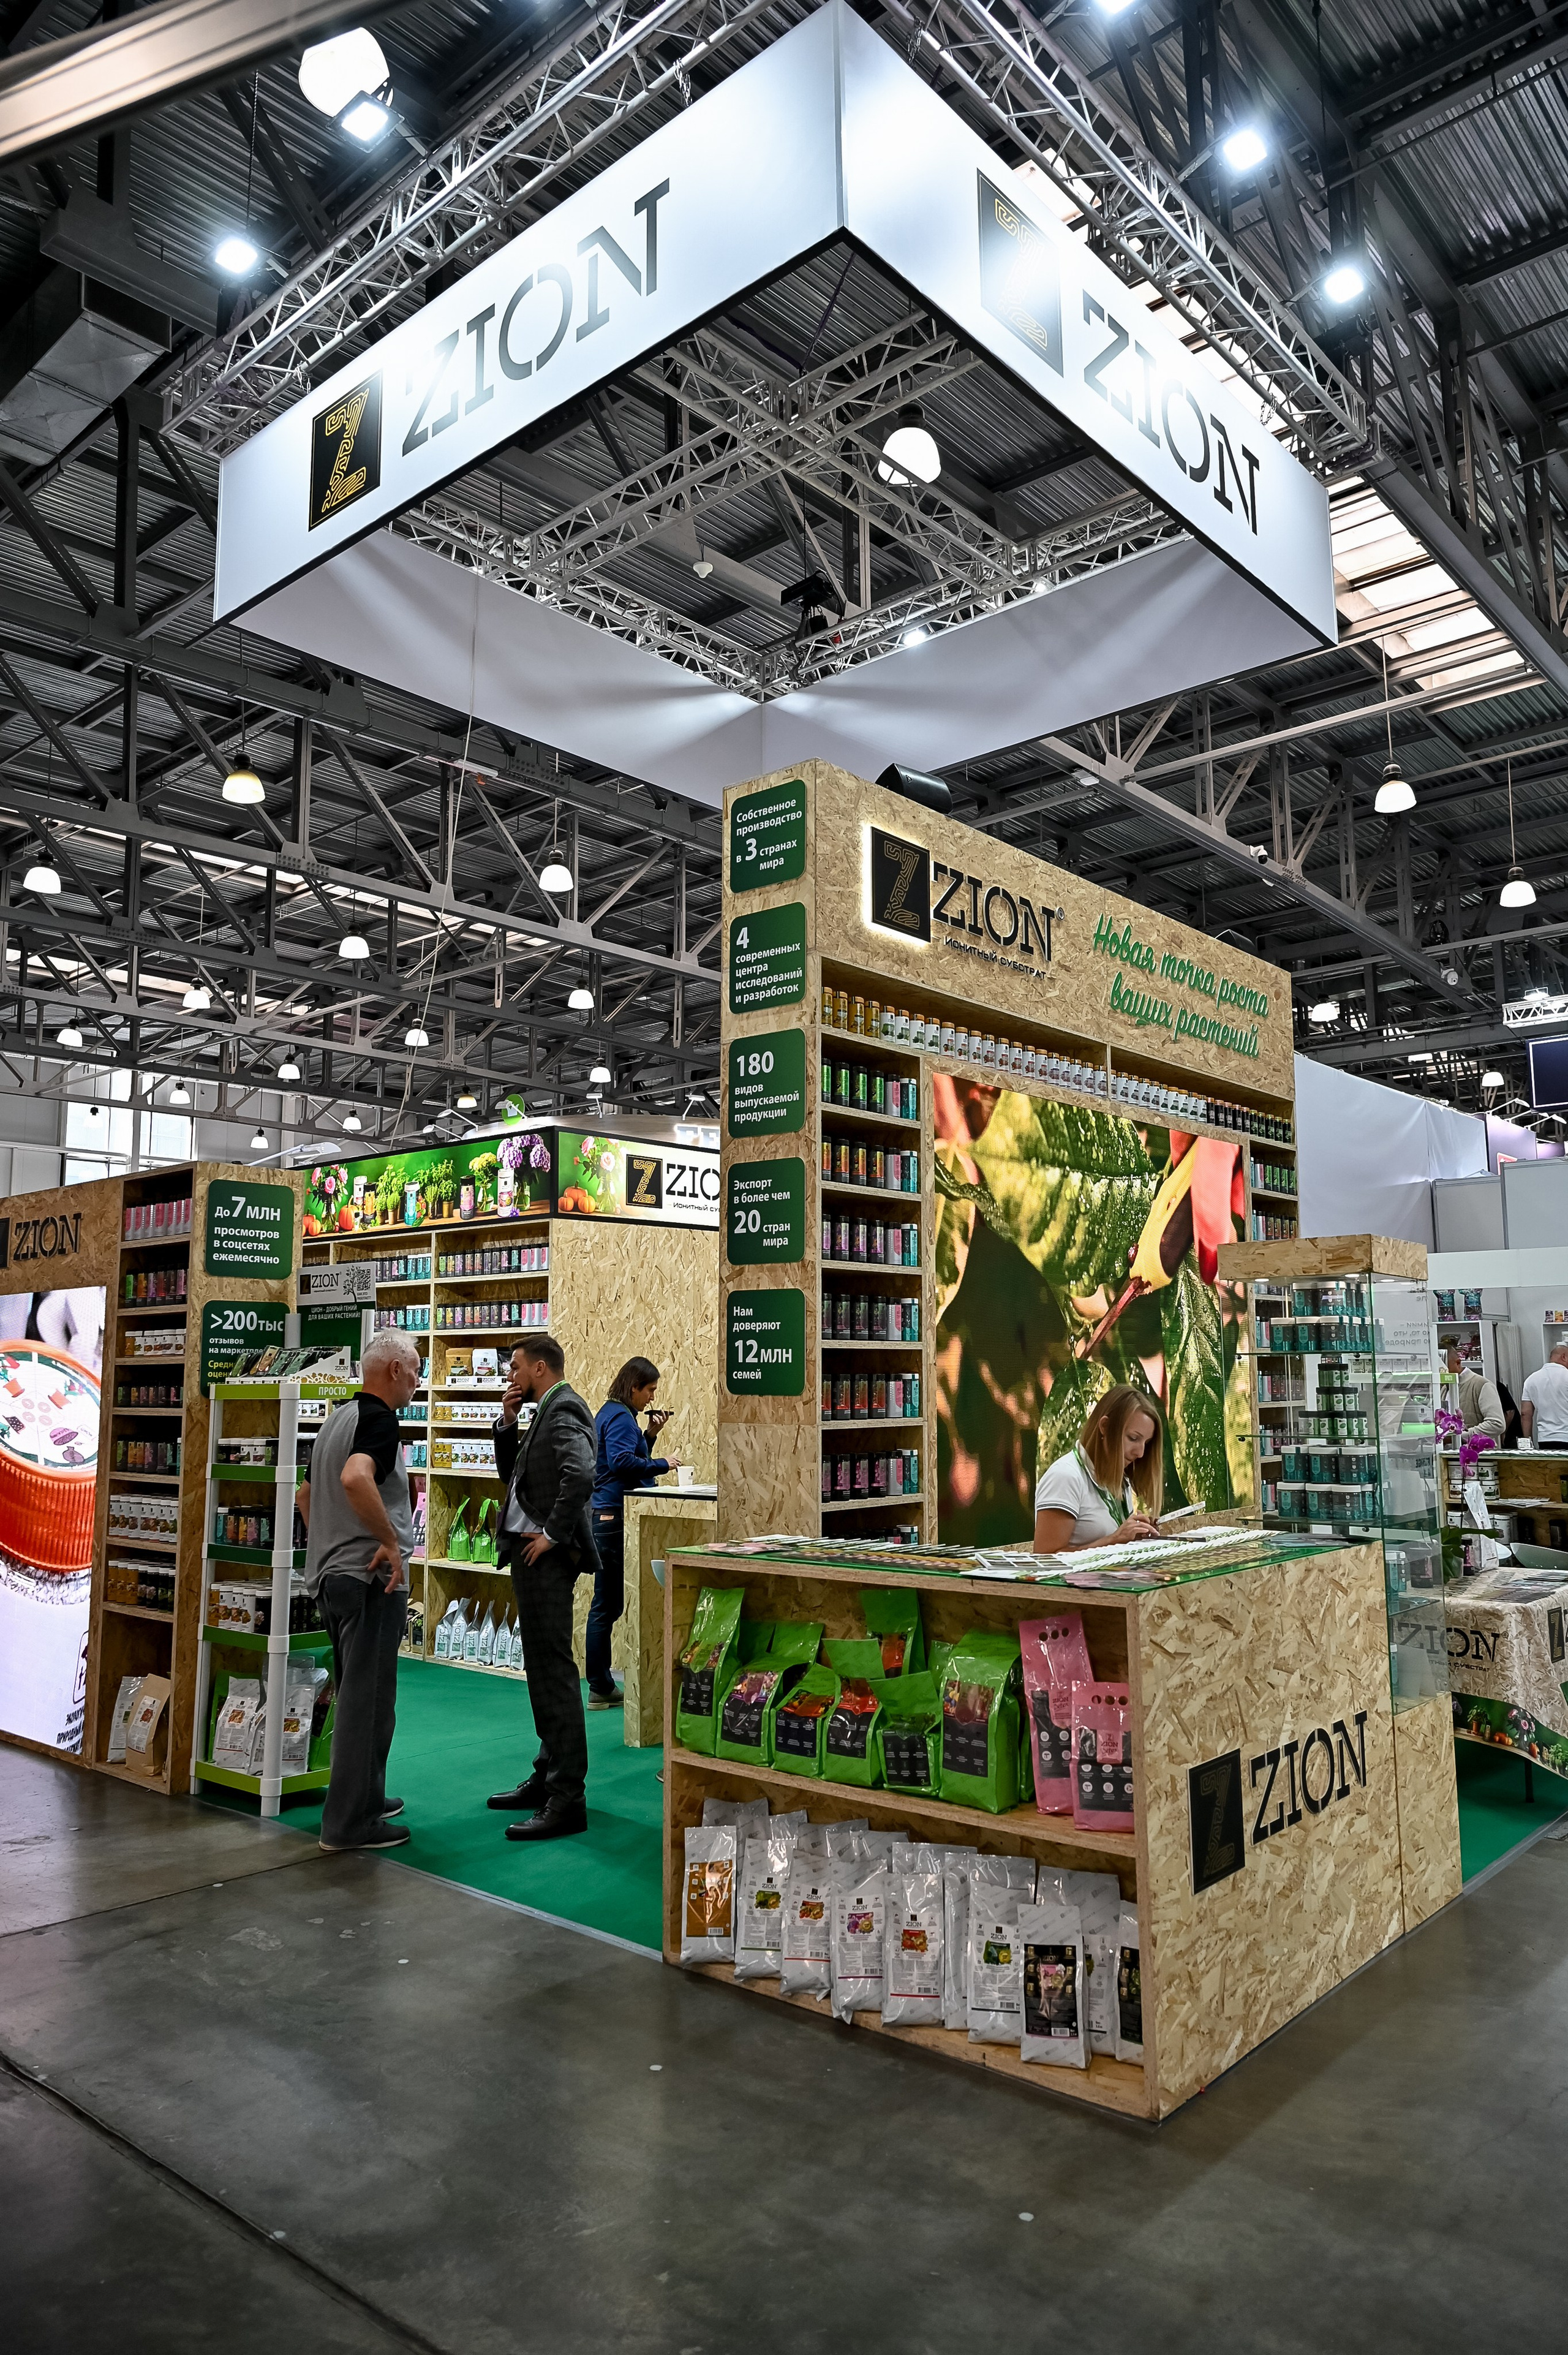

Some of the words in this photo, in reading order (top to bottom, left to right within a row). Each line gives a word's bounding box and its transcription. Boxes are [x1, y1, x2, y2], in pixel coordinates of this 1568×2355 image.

[402, 178, 669, 457] ZION
[1083, 289, 1260, 535] ZION
[736, 799, 796, 823] Собственное
[736, 810, 802, 837] производство
[736, 853, 742, 863] в
[745, 838, 757, 861] 3
[760, 839, 797, 856] странах
[760, 856, 784, 871] мира
[932, 860, 1055, 962] ZION
[736, 926, 750, 949] 4
[736, 942, 801, 964] современных
[736, 962, 768, 977] центра
[1000, 957, 1047, 980] СУБСТРАТ
[1093, 913, 1157, 975] Новая
[1159, 951, 1216, 997] точка
[1216, 976, 1269, 1018] роста
[736, 967, 802, 990] исследований
[736, 994, 741, 1003] и
[744, 983, 799, 1004] разработок
[1110, 971, 1173, 1029] ваших
[1174, 1007, 1259, 1059] растений
[737, 1051, 774, 1077] 180
[735, 1084, 763, 1096] видов
[735, 1091, 799, 1108] выпускаемой
[735, 1108, 786, 1124] продукции
[666, 1163, 720, 1201] ZIO
[734, 1179, 772, 1190] Экспорт
[214, 1206, 230, 1219] До
[232, 1196, 246, 1217] 7
[673, 1203, 708, 1212] ИОНИТНЫЙ
[741, 1193, 769, 1203] более
[772, 1192, 790, 1201] чем
[734, 1209, 761, 1233] 20
[763, 1223, 790, 1234] стран
[13, 1212, 85, 1261] ZION
[214, 1227, 280, 1240] просмотров
[763, 1237, 788, 1248] мира
[222, 1240, 270, 1251] соцсетях
[213, 1253, 279, 1264] ежемесячно
[311, 1273, 339, 1288] ZION
[733, 1306, 753, 1317] Нам
[733, 1321, 781, 1332] доверяют
[735, 1339, 758, 1363] 12
[208, 1360, 236, 1369] Средн
[733, 1369, 761, 1379] семей
[318, 1386, 347, 1396] ПРОСТО
[1249, 1709, 1368, 1846] ZION
